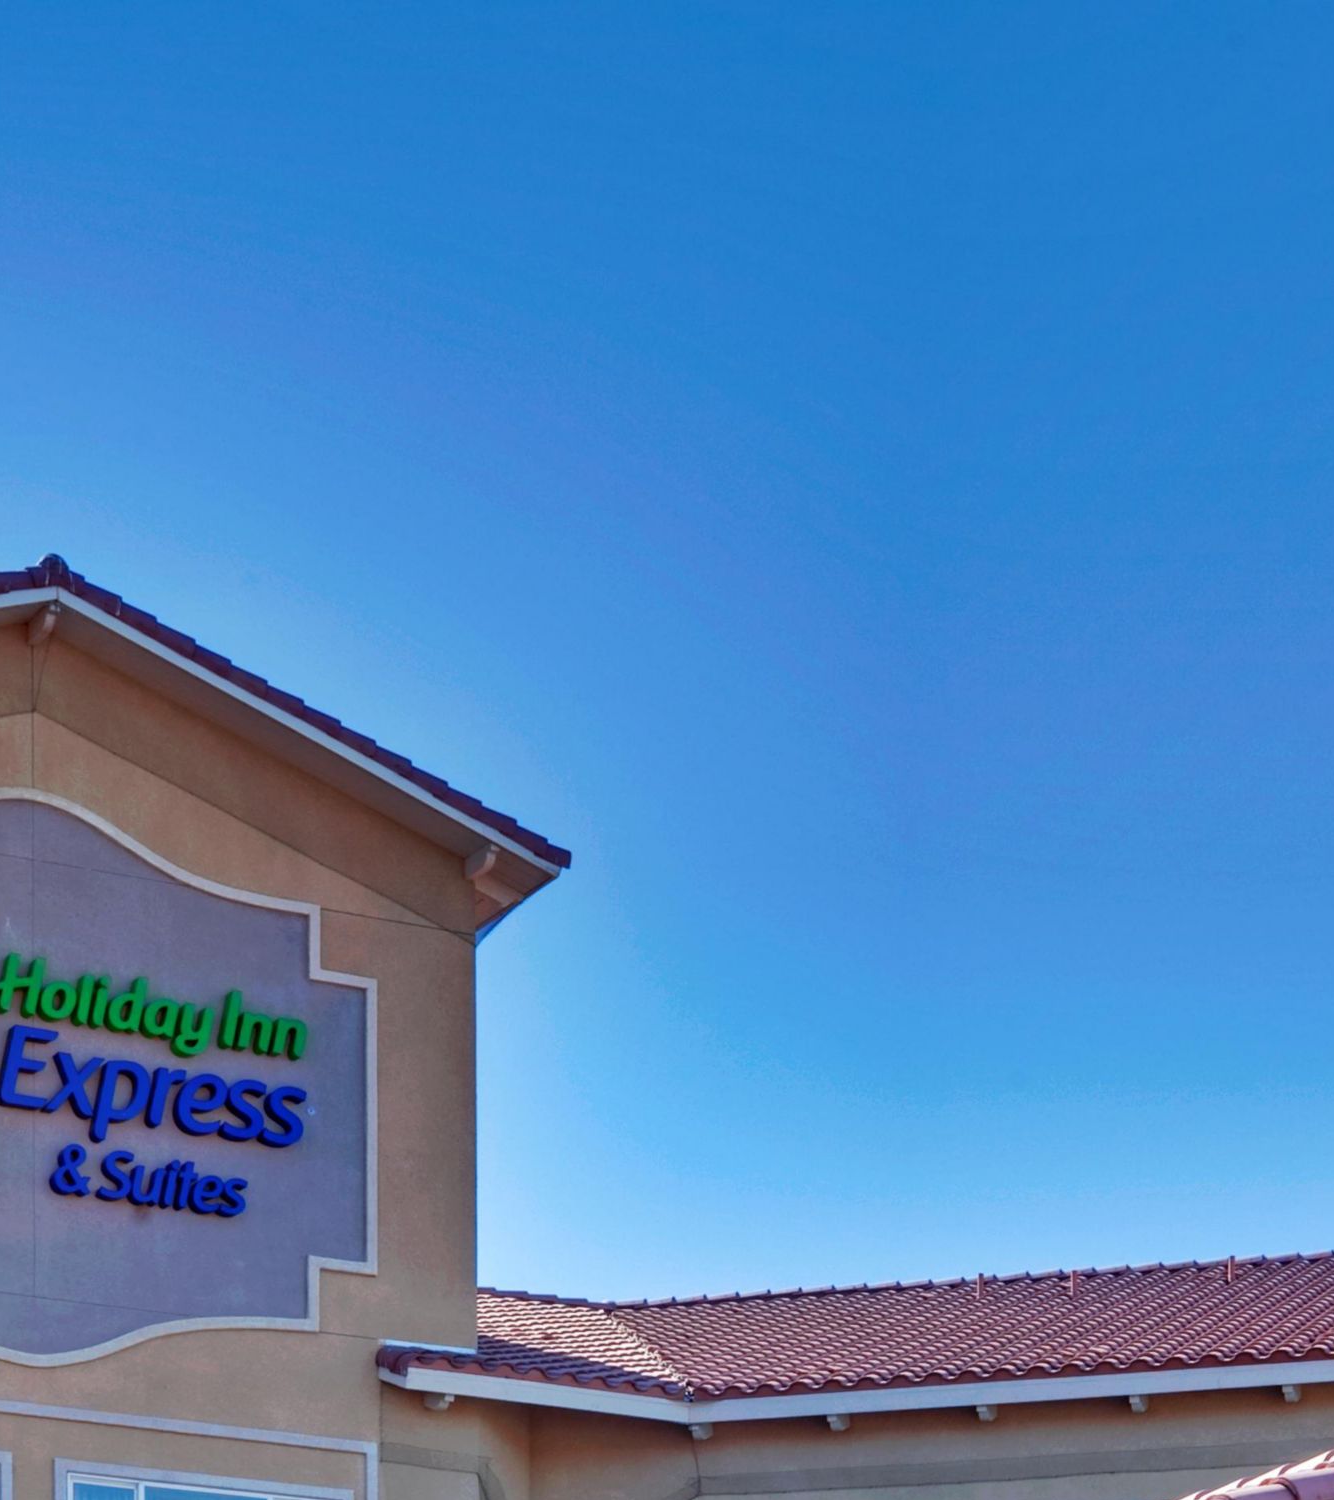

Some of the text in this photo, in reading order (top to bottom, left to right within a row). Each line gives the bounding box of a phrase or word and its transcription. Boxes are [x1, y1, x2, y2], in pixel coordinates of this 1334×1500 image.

[217, 989, 308, 1060] Inn
[49, 1143, 248, 1217] & Suites
